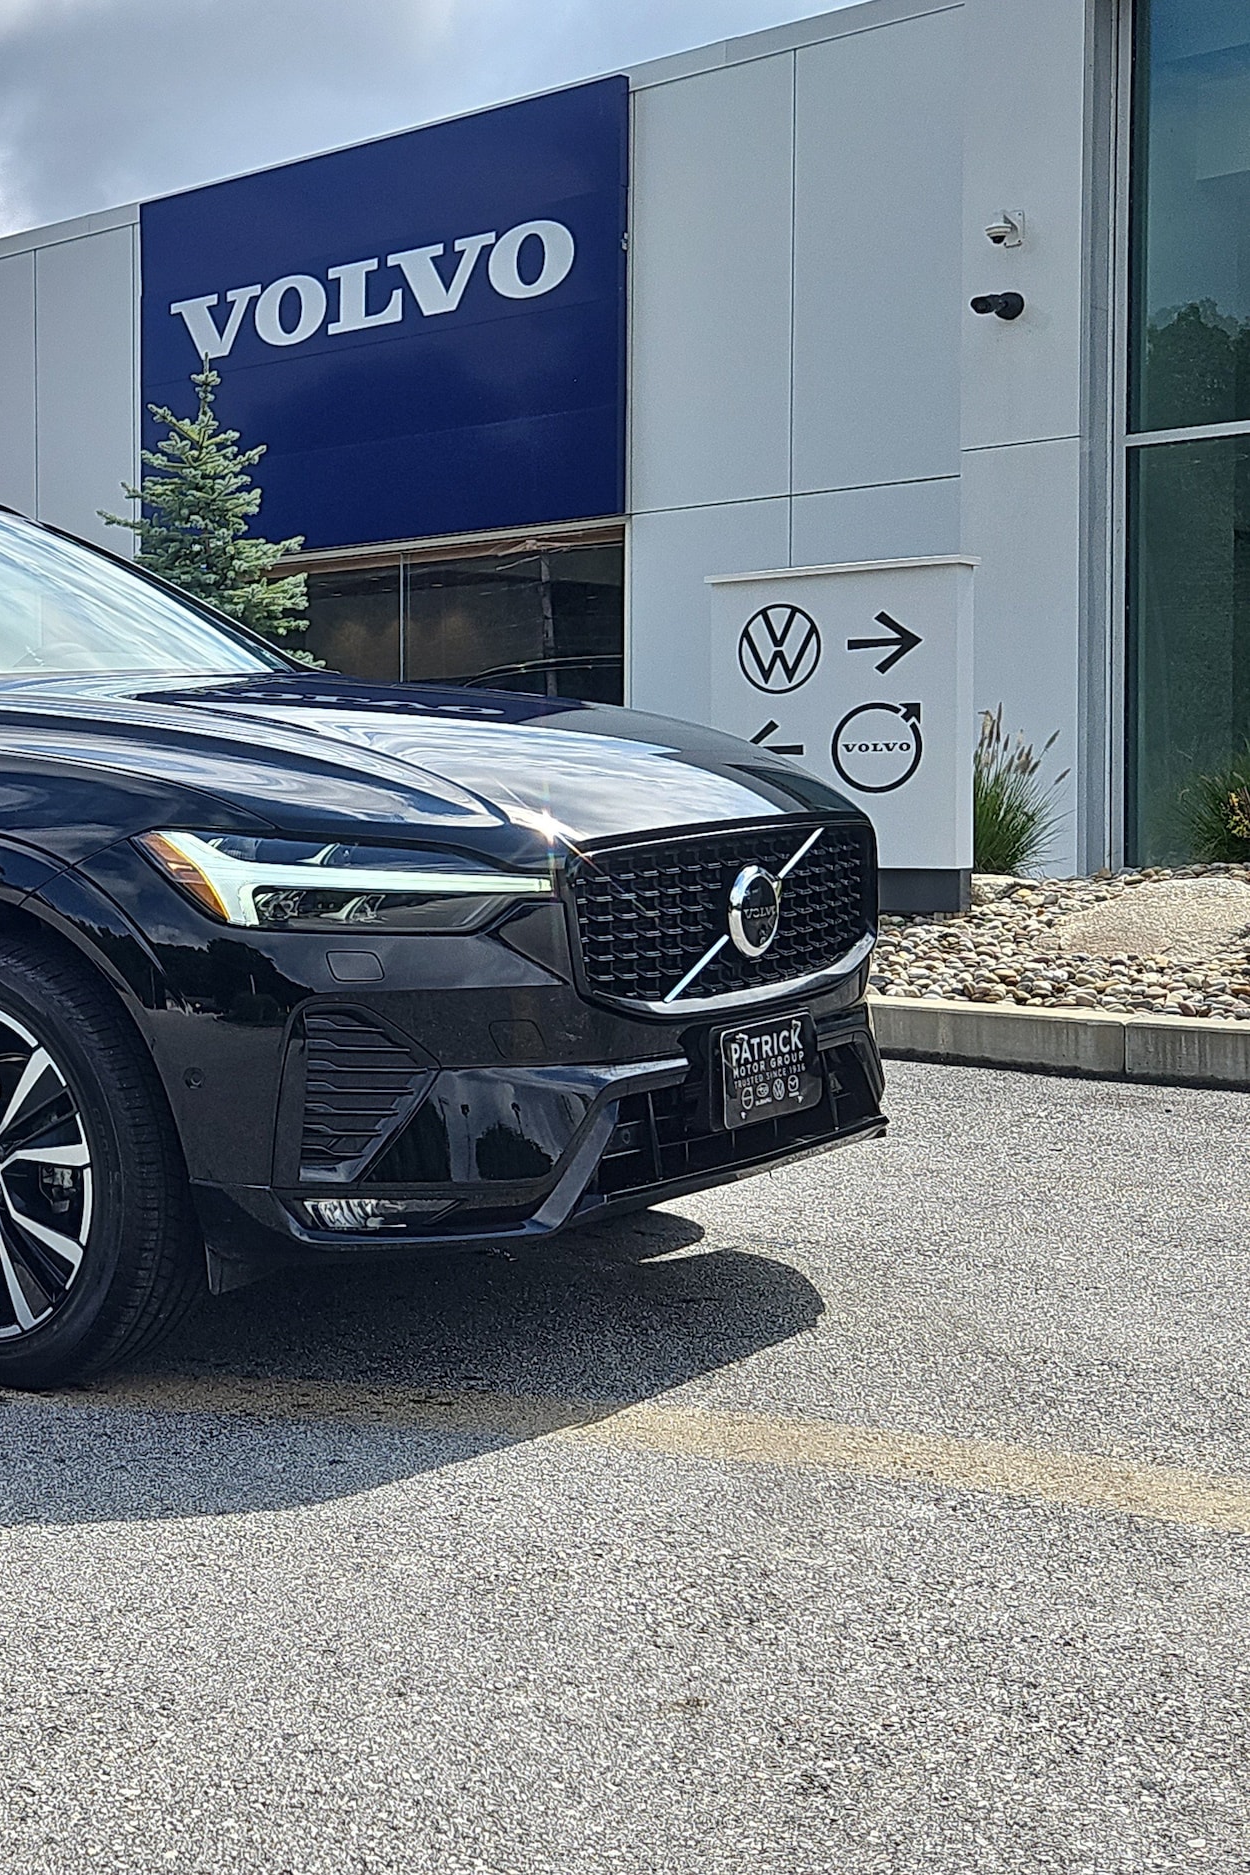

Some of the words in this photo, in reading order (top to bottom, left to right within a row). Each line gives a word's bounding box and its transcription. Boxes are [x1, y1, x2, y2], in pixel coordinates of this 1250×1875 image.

[170, 220, 575, 360] VOLVO
[842, 741, 911, 753] VOLVO
[743, 905, 776, 919] VOLV
[731, 1026, 803, 1067] PATRICK
[733, 1060, 765, 1079] MOTOR
[770, 1051, 804, 1068] GROUP
[734, 1073, 764, 1089] TRUSTED
[766, 1067, 787, 1081] SINCE
